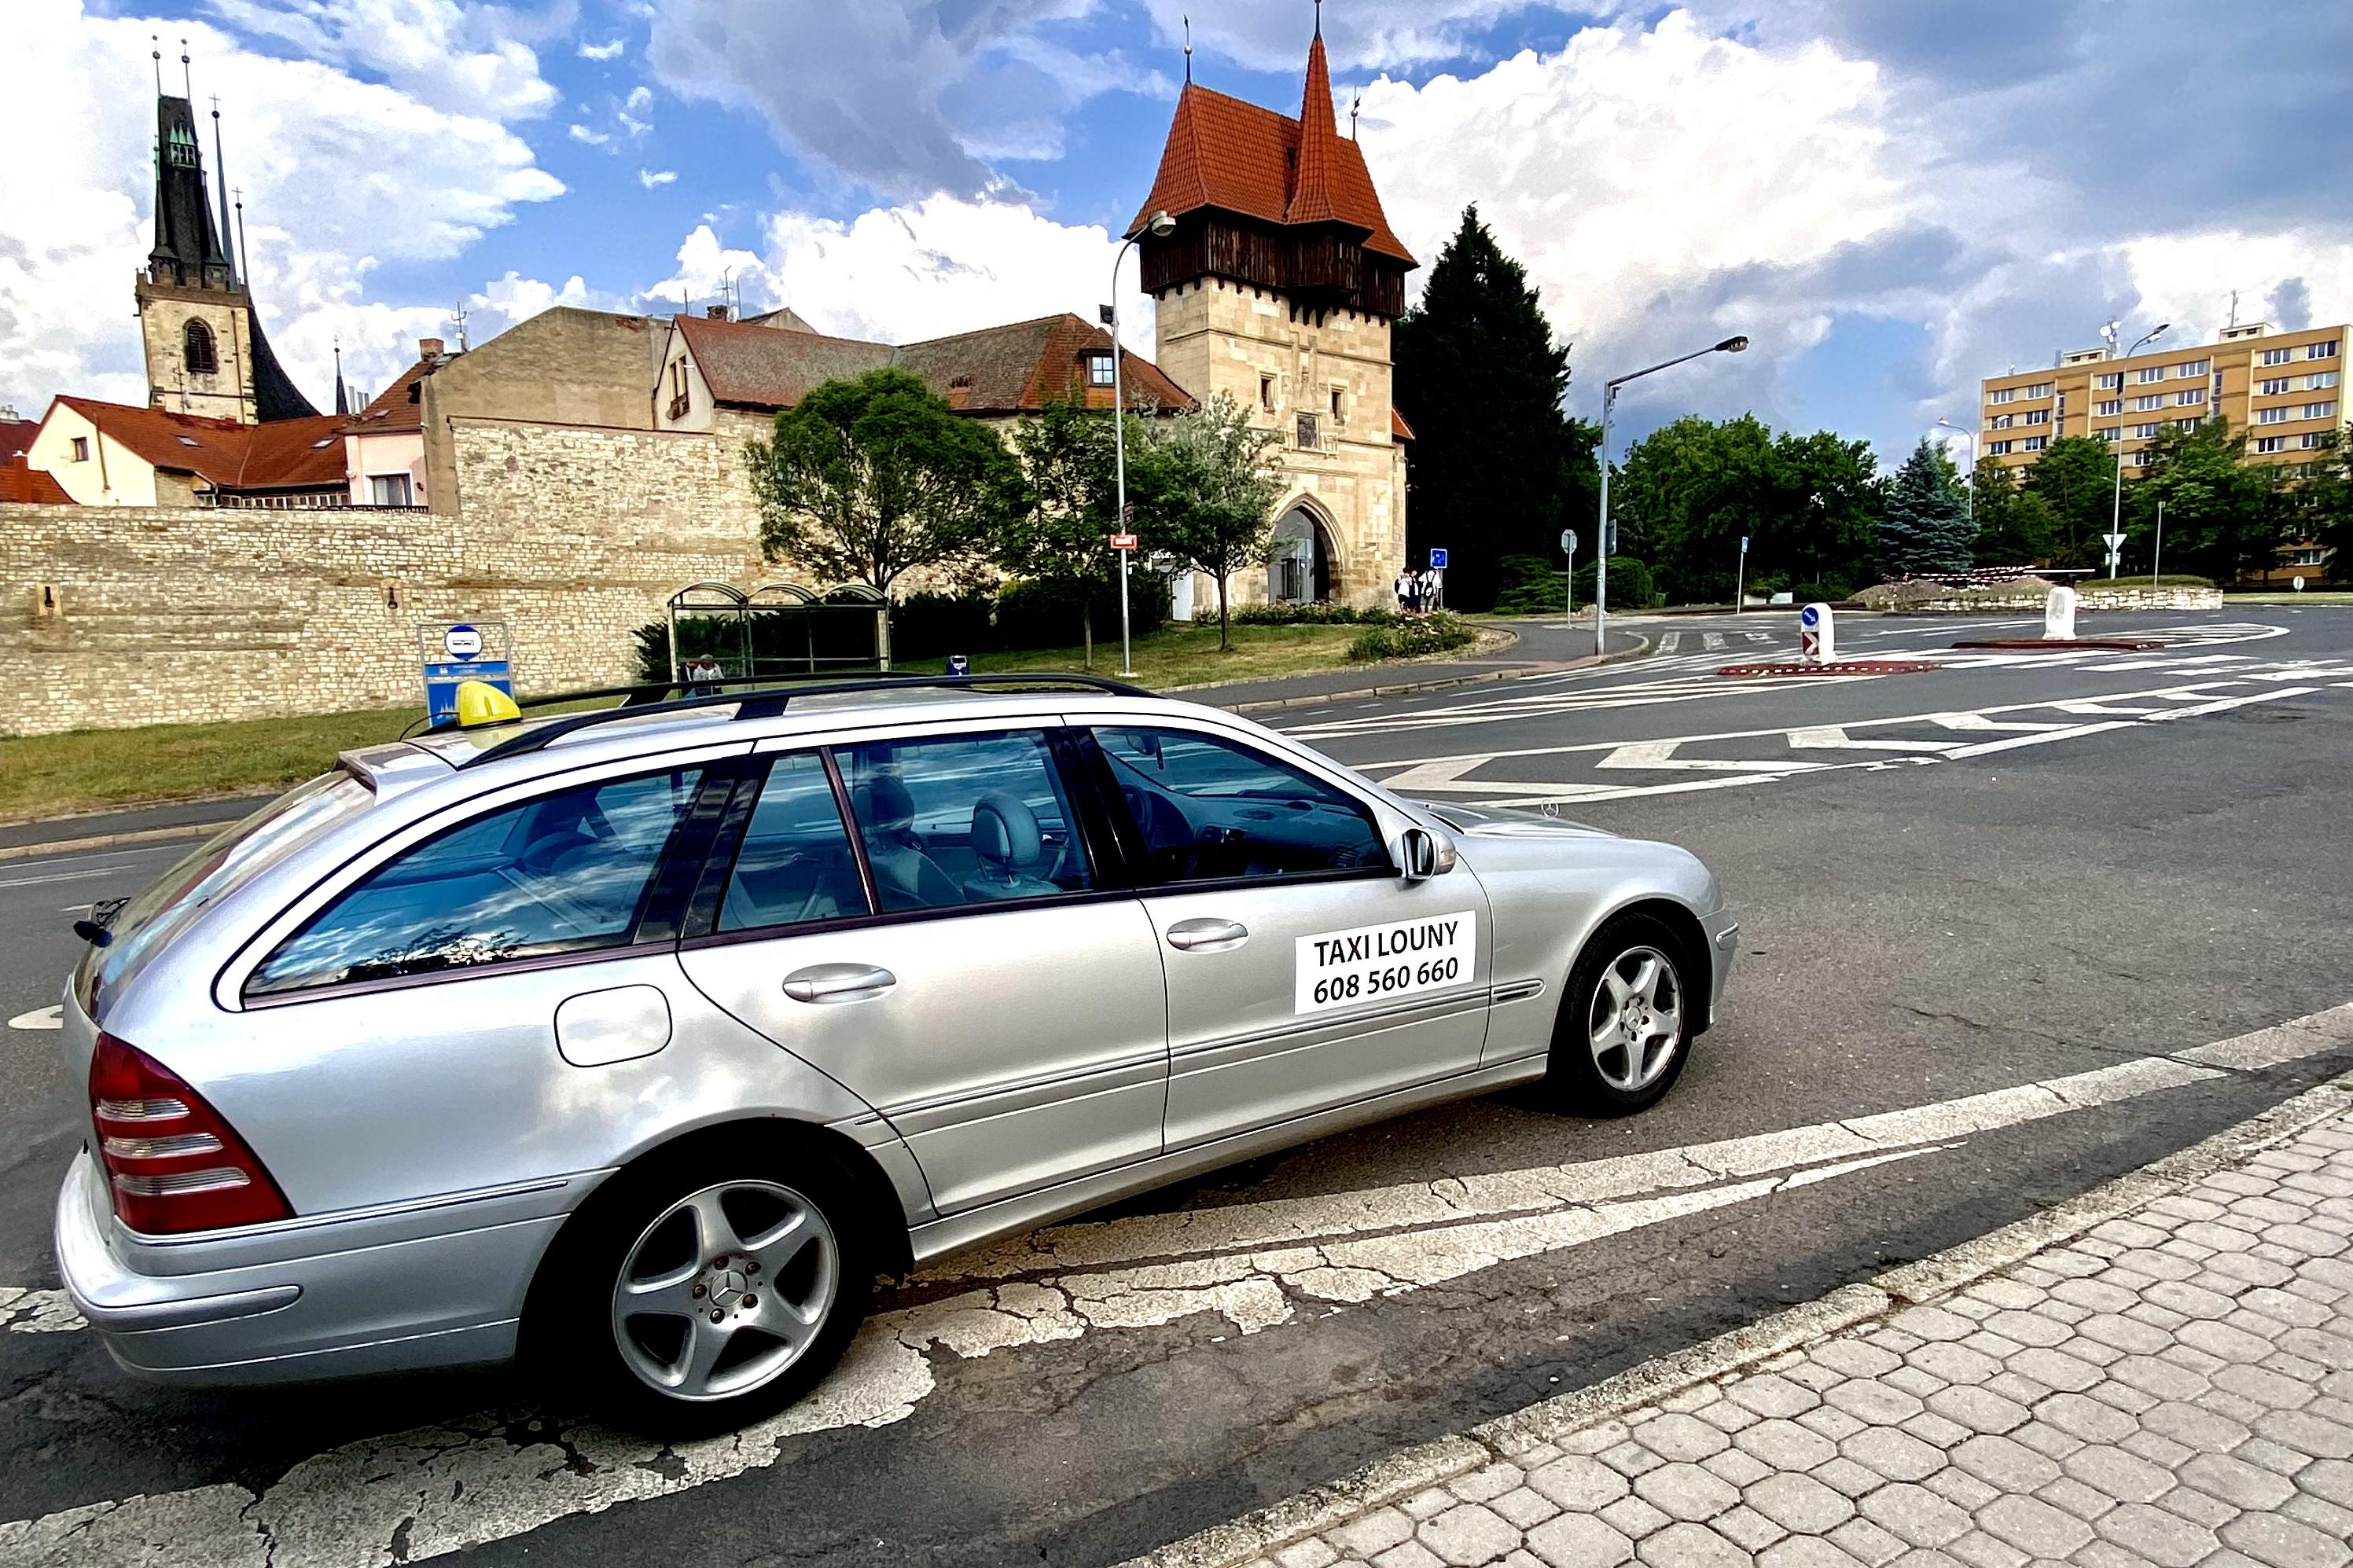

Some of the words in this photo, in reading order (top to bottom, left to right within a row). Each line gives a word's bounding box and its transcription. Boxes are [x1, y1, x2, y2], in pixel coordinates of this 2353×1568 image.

[1314, 935, 1370, 967] TAXI
[1378, 920, 1458, 957] LOUNY
[1314, 974, 1359, 1004] 608
[1367, 965, 1410, 994] 560
[1417, 957, 1458, 985] 660
